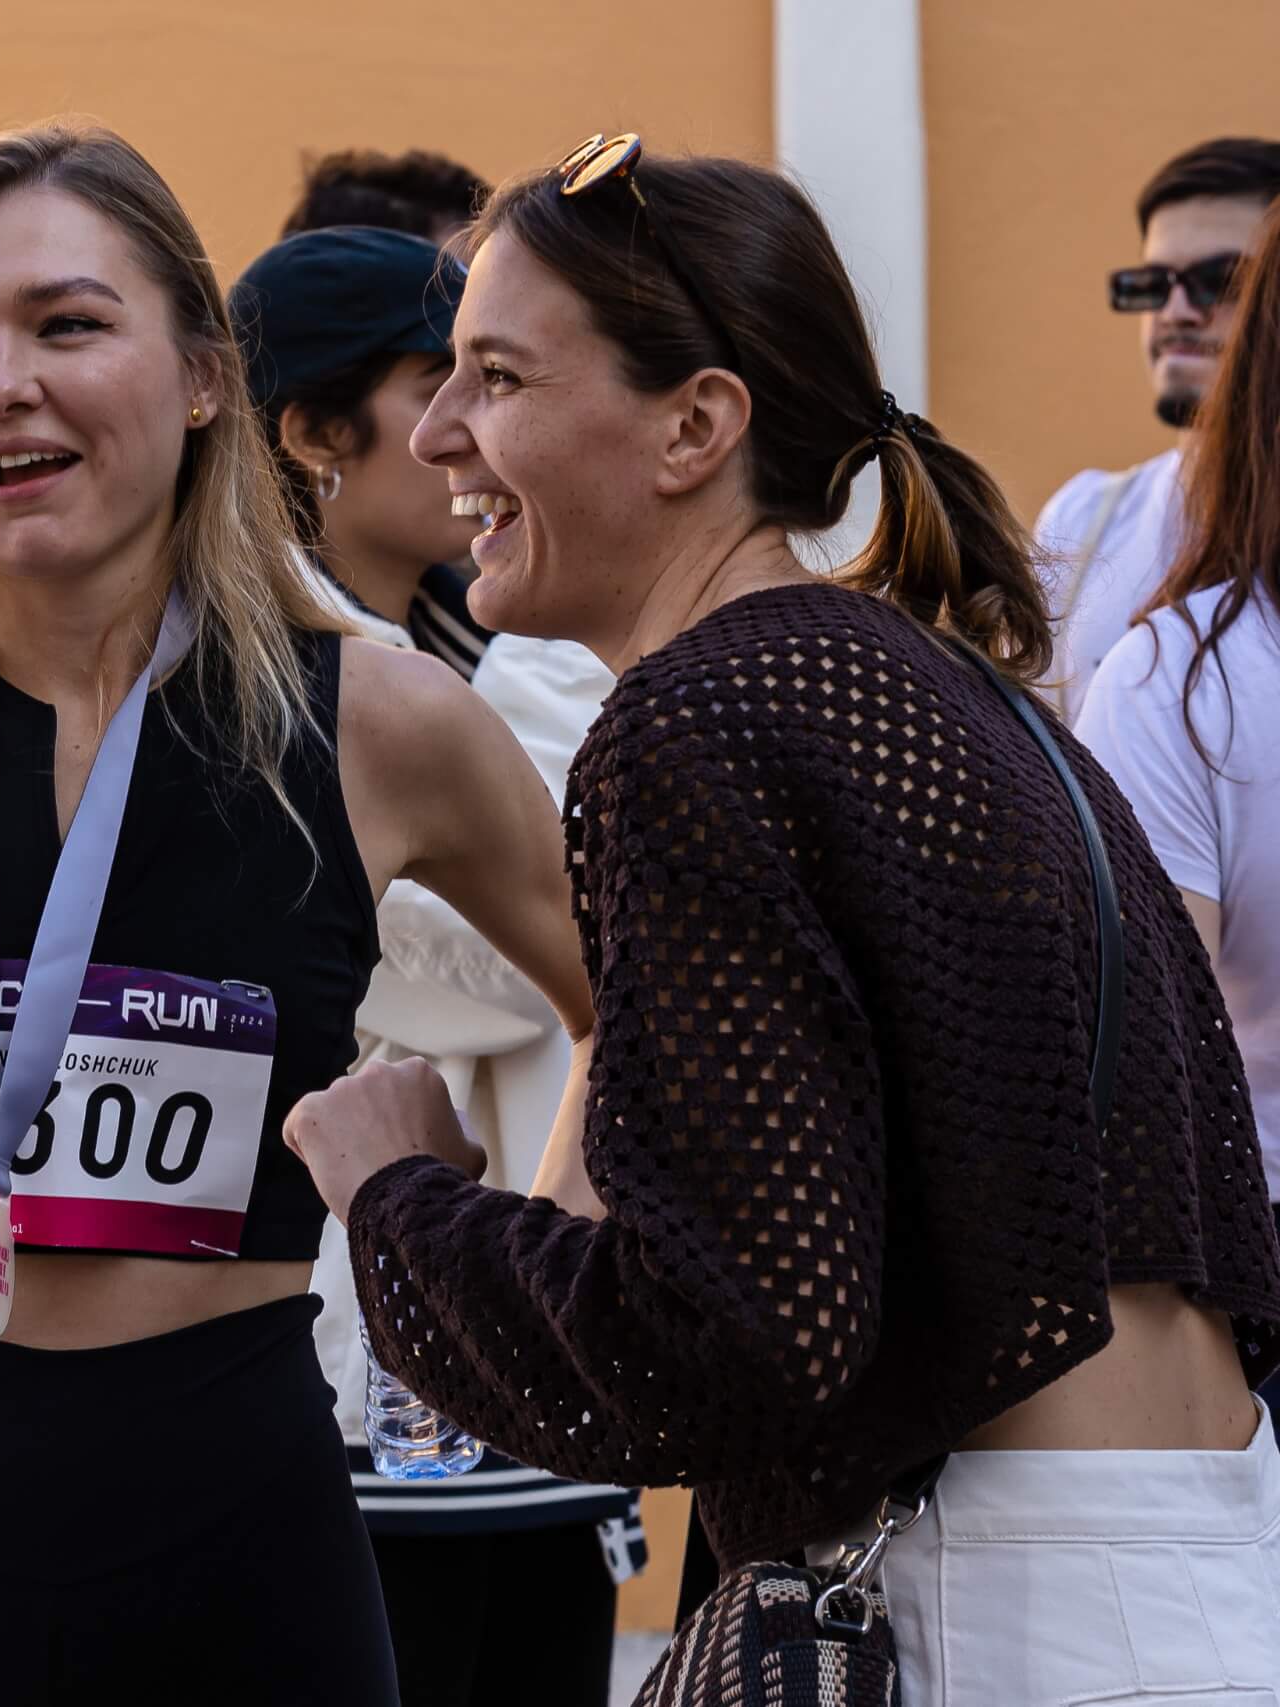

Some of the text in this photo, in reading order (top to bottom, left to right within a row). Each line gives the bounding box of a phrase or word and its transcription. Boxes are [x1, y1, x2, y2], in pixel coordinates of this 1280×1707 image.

[121, 988, 218, 1032] RUN
[230, 1014, 263, 1026] 2024
[57, 1053, 160, 1077] OSHCHUK
